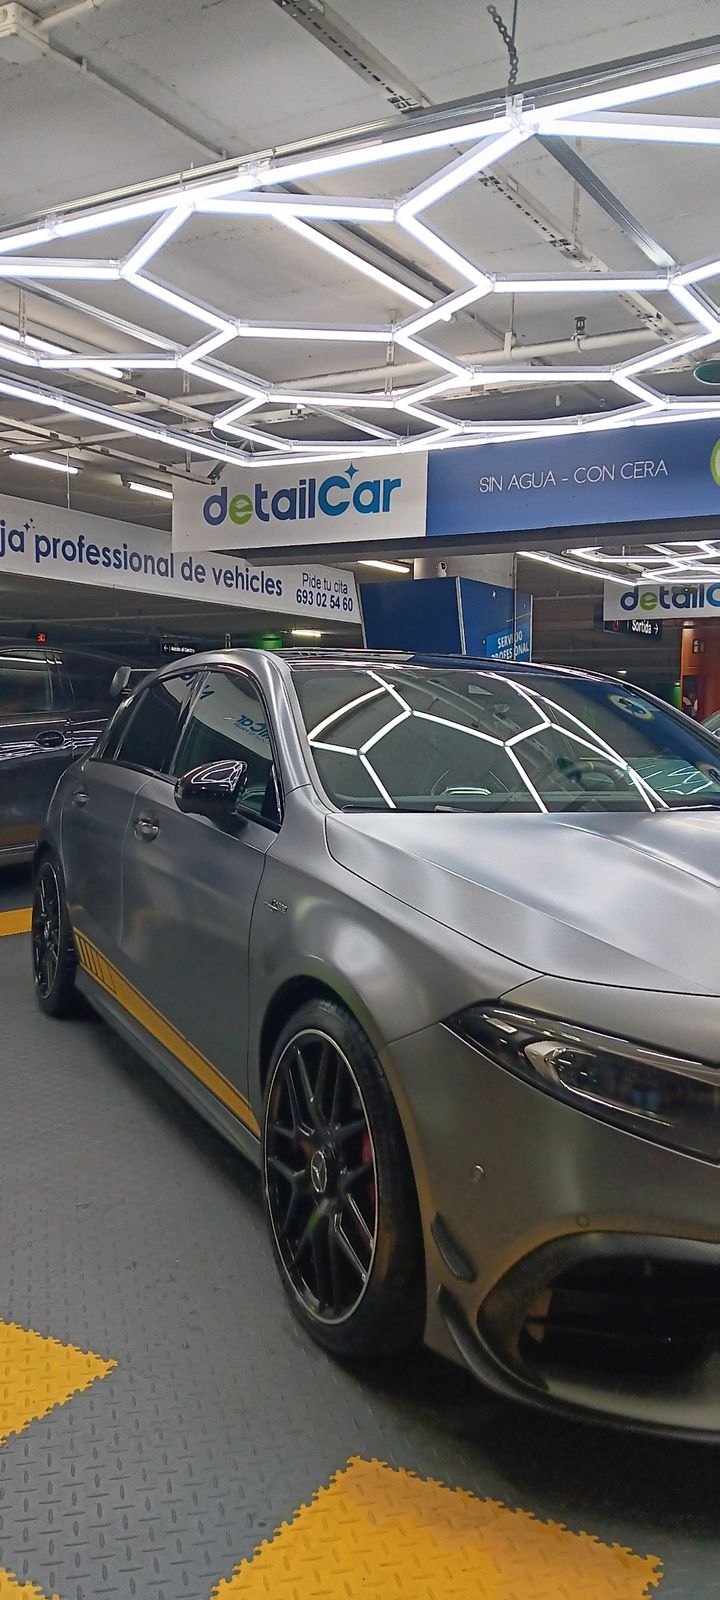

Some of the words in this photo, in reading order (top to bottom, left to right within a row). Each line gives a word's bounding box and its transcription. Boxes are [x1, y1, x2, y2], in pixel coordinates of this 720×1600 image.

[479, 475, 503, 493] SIN
[507, 470, 557, 491] AGUA
[573, 464, 616, 484] CON
[620, 459, 669, 480] CERA
[203, 475, 402, 526] detailCar
[35, 534, 174, 579] professional
[181, 556, 207, 584] de
[212, 565, 283, 597] vehicles
[302, 572, 322, 590] Pide
[323, 578, 333, 592] tu
[333, 579, 348, 595] cita
[296, 588, 314, 605] 693
[316, 592, 328, 608] 02
[329, 595, 341, 610] 54
[342, 597, 354, 612] 60
[631, 619, 652, 635] Sortida
